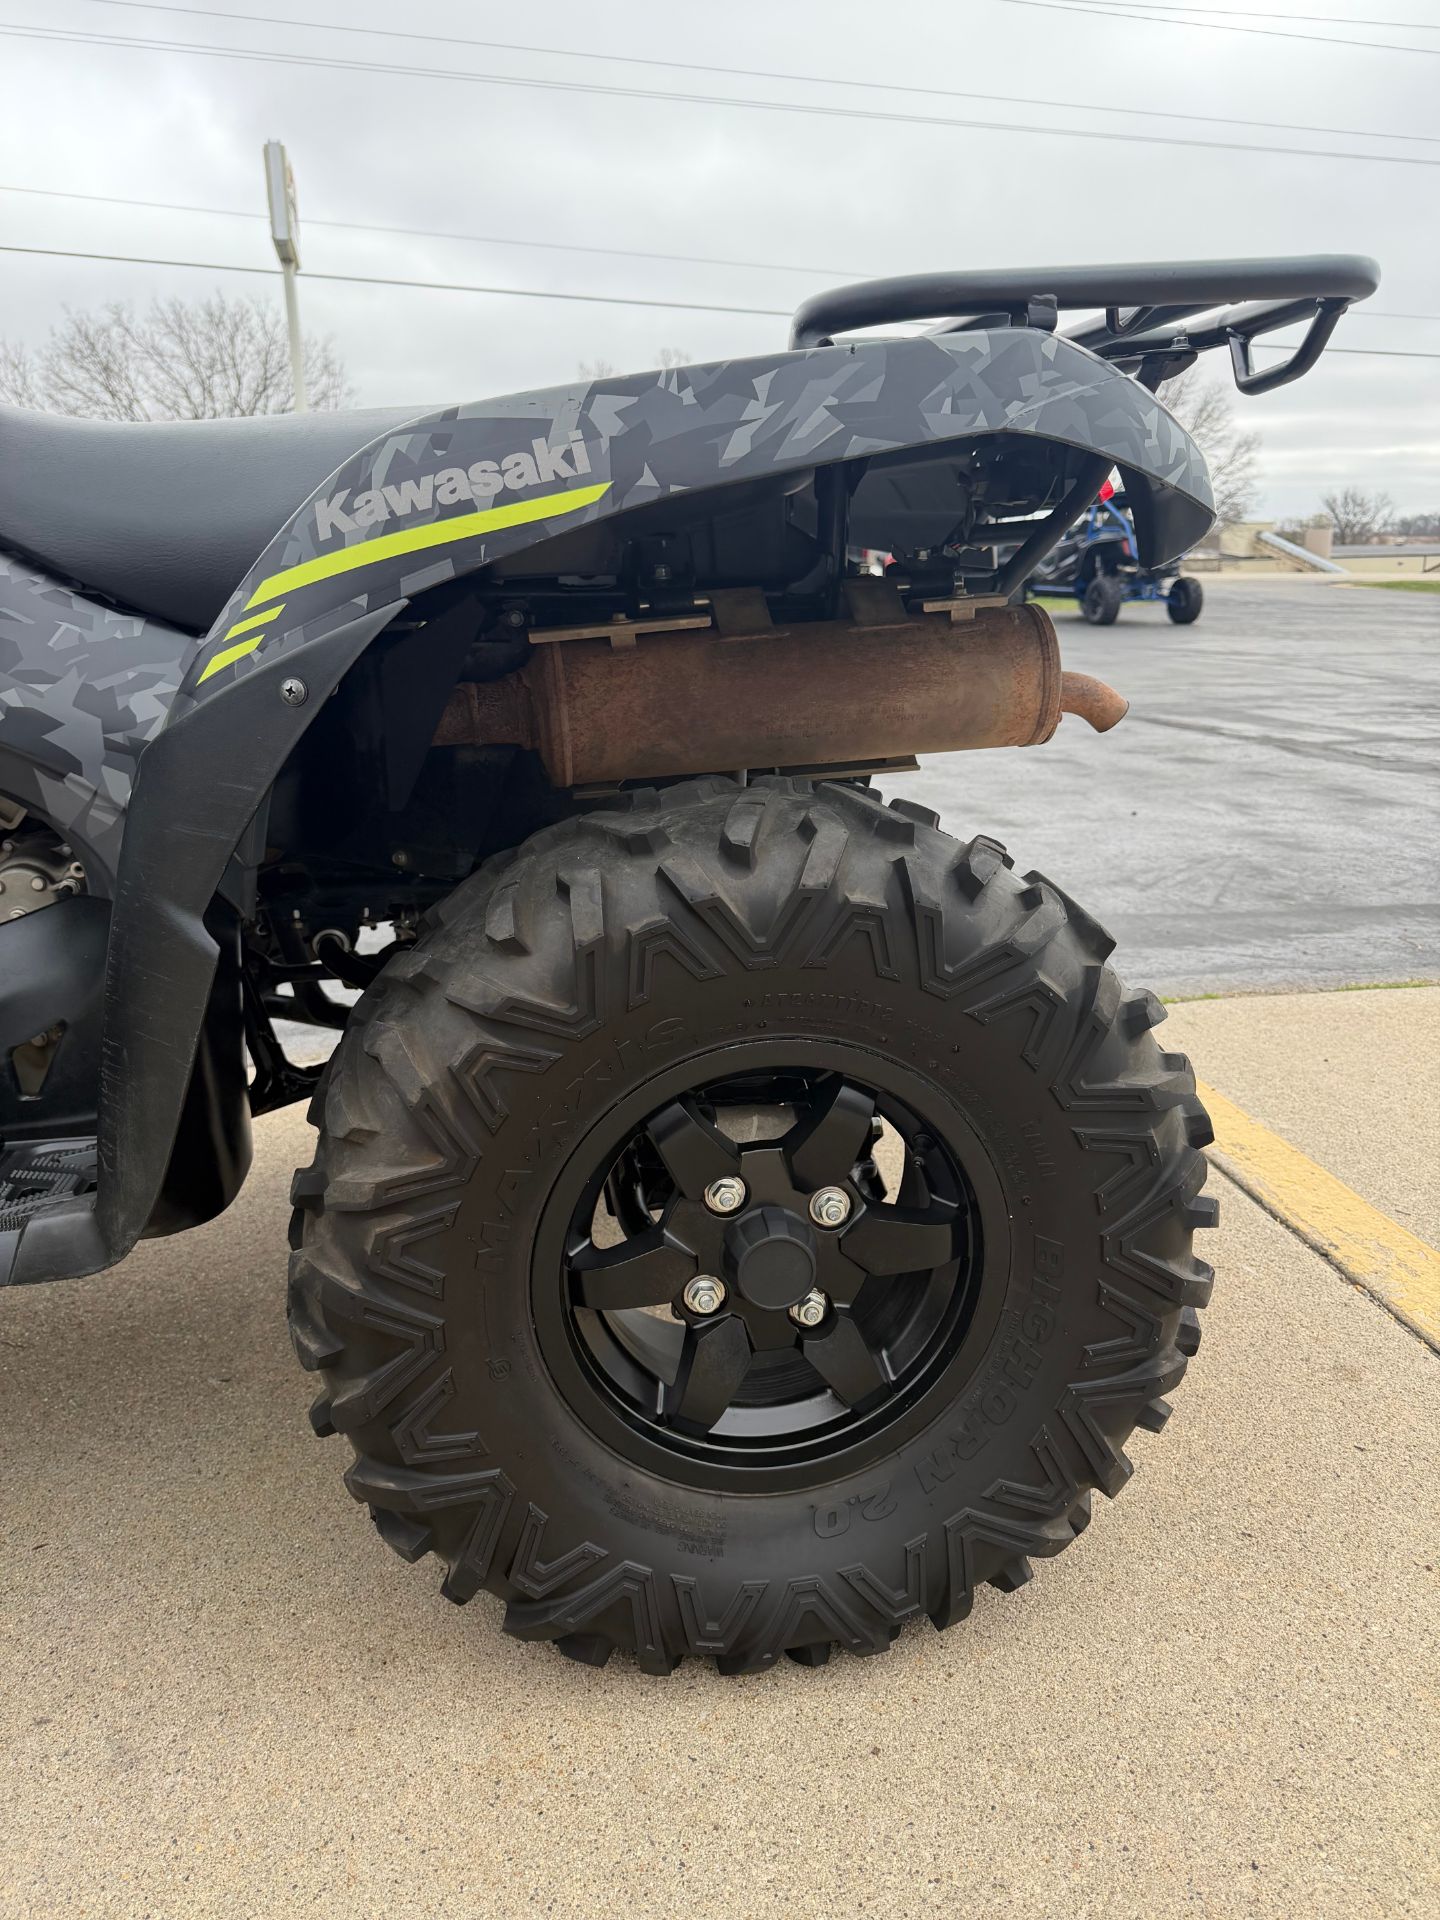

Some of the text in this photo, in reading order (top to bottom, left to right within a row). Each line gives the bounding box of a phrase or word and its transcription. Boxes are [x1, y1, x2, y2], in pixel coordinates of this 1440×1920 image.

[315, 431, 592, 541] Kawasaki
[474, 1016, 686, 1274] MAXXIS
[913, 1233, 1065, 1495] BIGHORN
[813, 1480, 899, 1539] 2.0
